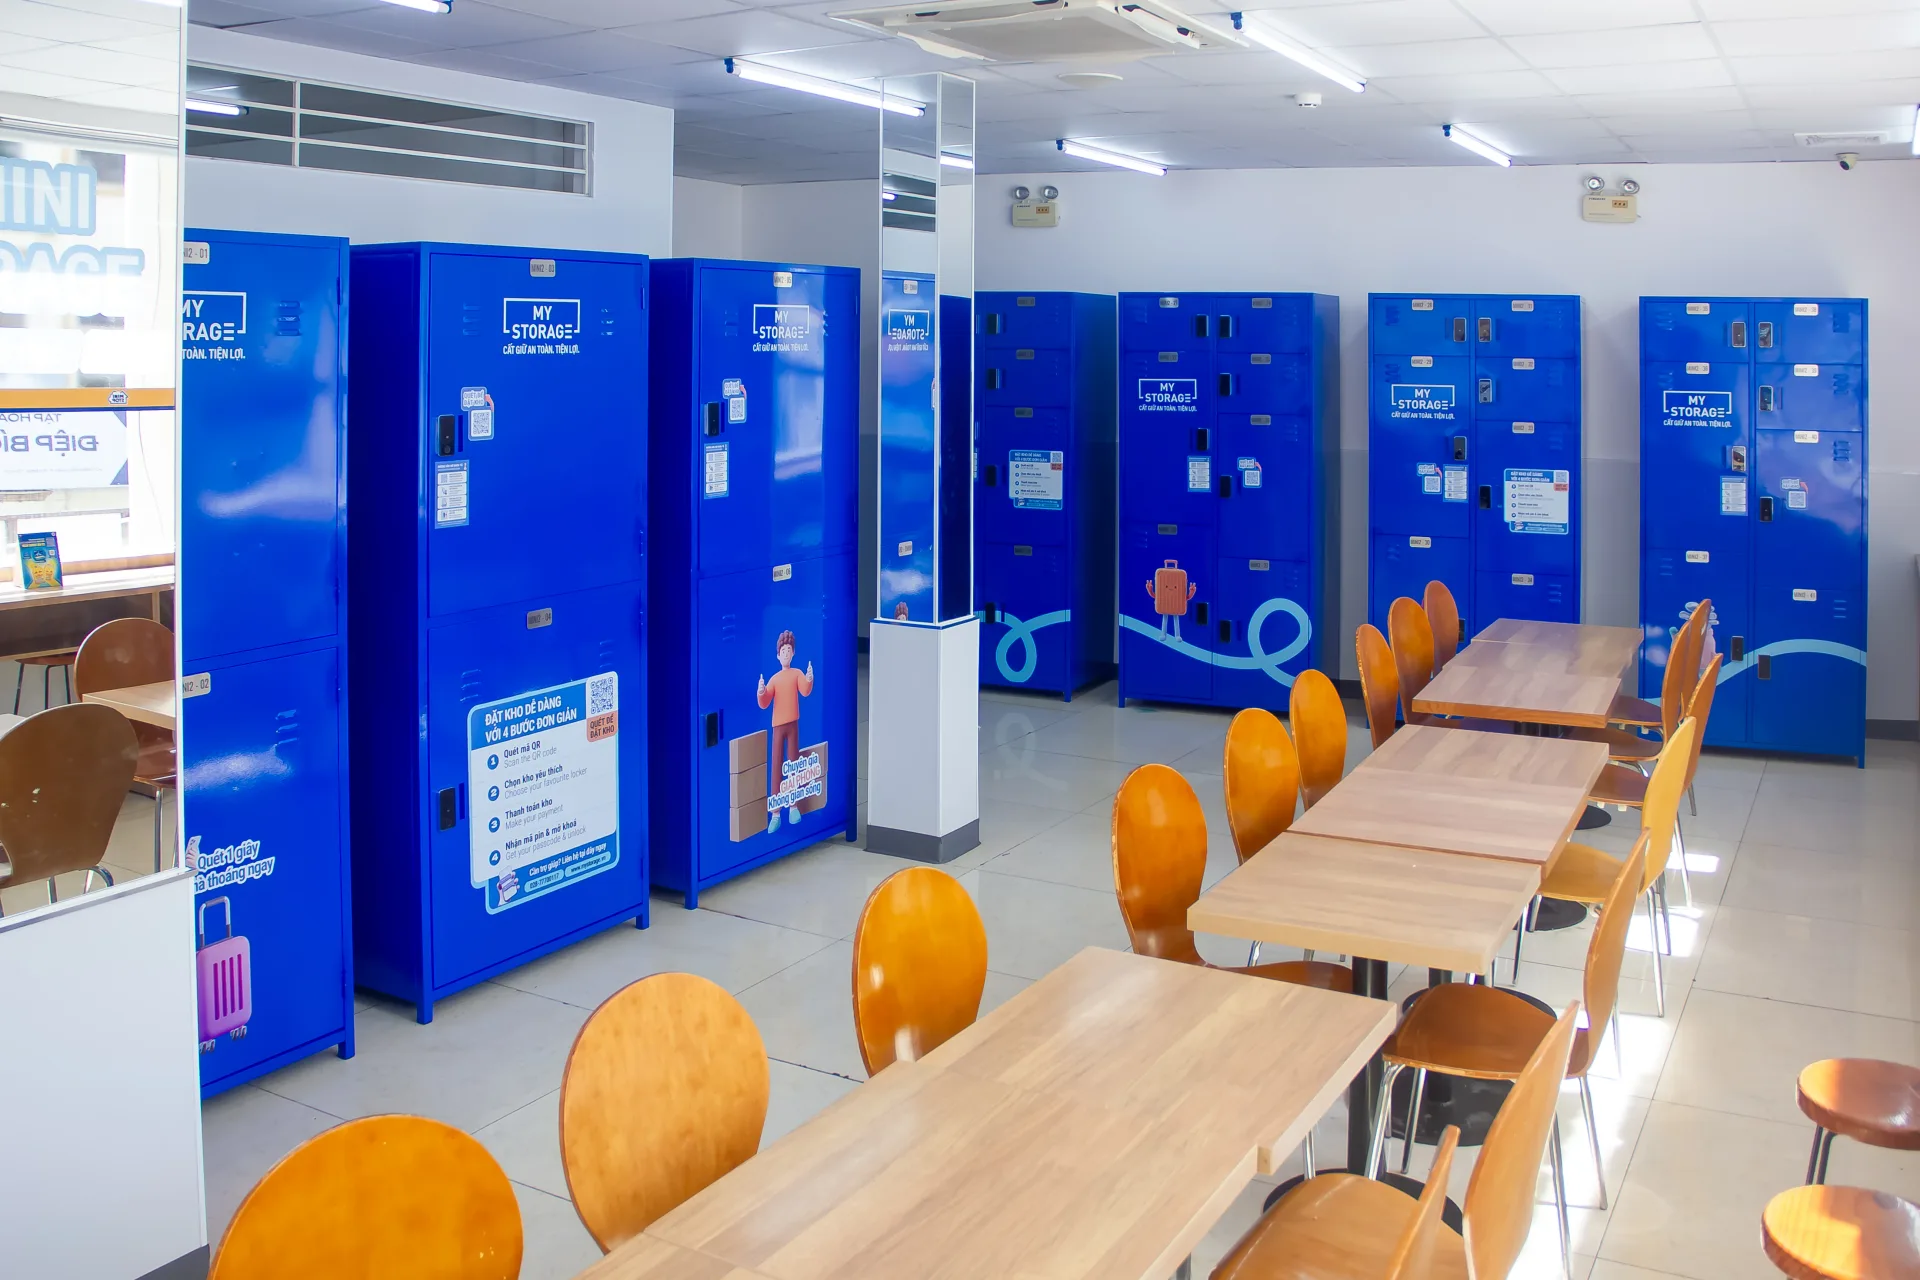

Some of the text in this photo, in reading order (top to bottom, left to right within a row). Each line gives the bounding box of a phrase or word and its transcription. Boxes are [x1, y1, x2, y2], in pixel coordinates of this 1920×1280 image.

[0, 164, 90, 229] INI
[200, 248, 207, 258] 01
[533, 306, 552, 321] MY
[775, 311, 788, 323] MY
[183, 323, 235, 341] RAGE
[512, 324, 573, 339] STORAGE
[760, 326, 804, 339] STORAGE
[209, 347, 229, 361] TIỆN
[230, 348, 245, 361] LỢI.
[503, 343, 515, 354] CẤT
[527, 346, 536, 354] AN
[537, 343, 554, 354] TOÀN.
[555, 343, 568, 355] TIỆN
[1160, 383, 1175, 392] MY
[1415, 389, 1431, 398] MY
[1145, 394, 1191, 403] STORAGE
[1399, 400, 1449, 410] STORAGE
[1689, 396, 1706, 405] MY
[1671, 407, 1725, 418] STORAGE
[200, 679, 209, 689] 02
[485, 696, 562, 727] ĐẶT KHO DỄ DÀNG
[486, 707, 577, 743] VỚI 4 BƯỚC ĐƠN GIẢN
[590, 717, 605, 729] QUÉT
[603, 725, 615, 735] KHO
[504, 741, 541, 758] Quét mã QR
[491, 757, 496, 766] 1
[504, 746, 557, 769] Scan the QR code
[784, 754, 818, 775] Chuyên gia
[504, 764, 563, 789] Chọn kho yêu thích
[505, 767, 588, 800] Choose your favourite locker
[491, 788, 497, 797] 2
[769, 794, 790, 810] Không
[791, 789, 805, 804] gian
[505, 798, 553, 820] Thanh toán kho
[506, 804, 564, 830] Make your payment
[491, 821, 497, 829] 3
[506, 839, 522, 850] Nhận
[524, 834, 533, 845] mã
[535, 831, 545, 843] pin
[546, 829, 550, 837] &
[506, 850, 517, 861] Get
[518, 845, 532, 858] your
[533, 835, 561, 852] passcode
[568, 826, 587, 839] unlock
[198, 842, 258, 870] Quét 1 giây
[492, 853, 498, 862] 4
[562, 854, 573, 865] Liên
[208, 868, 246, 888] thoáng
[248, 858, 274, 877] ngay
